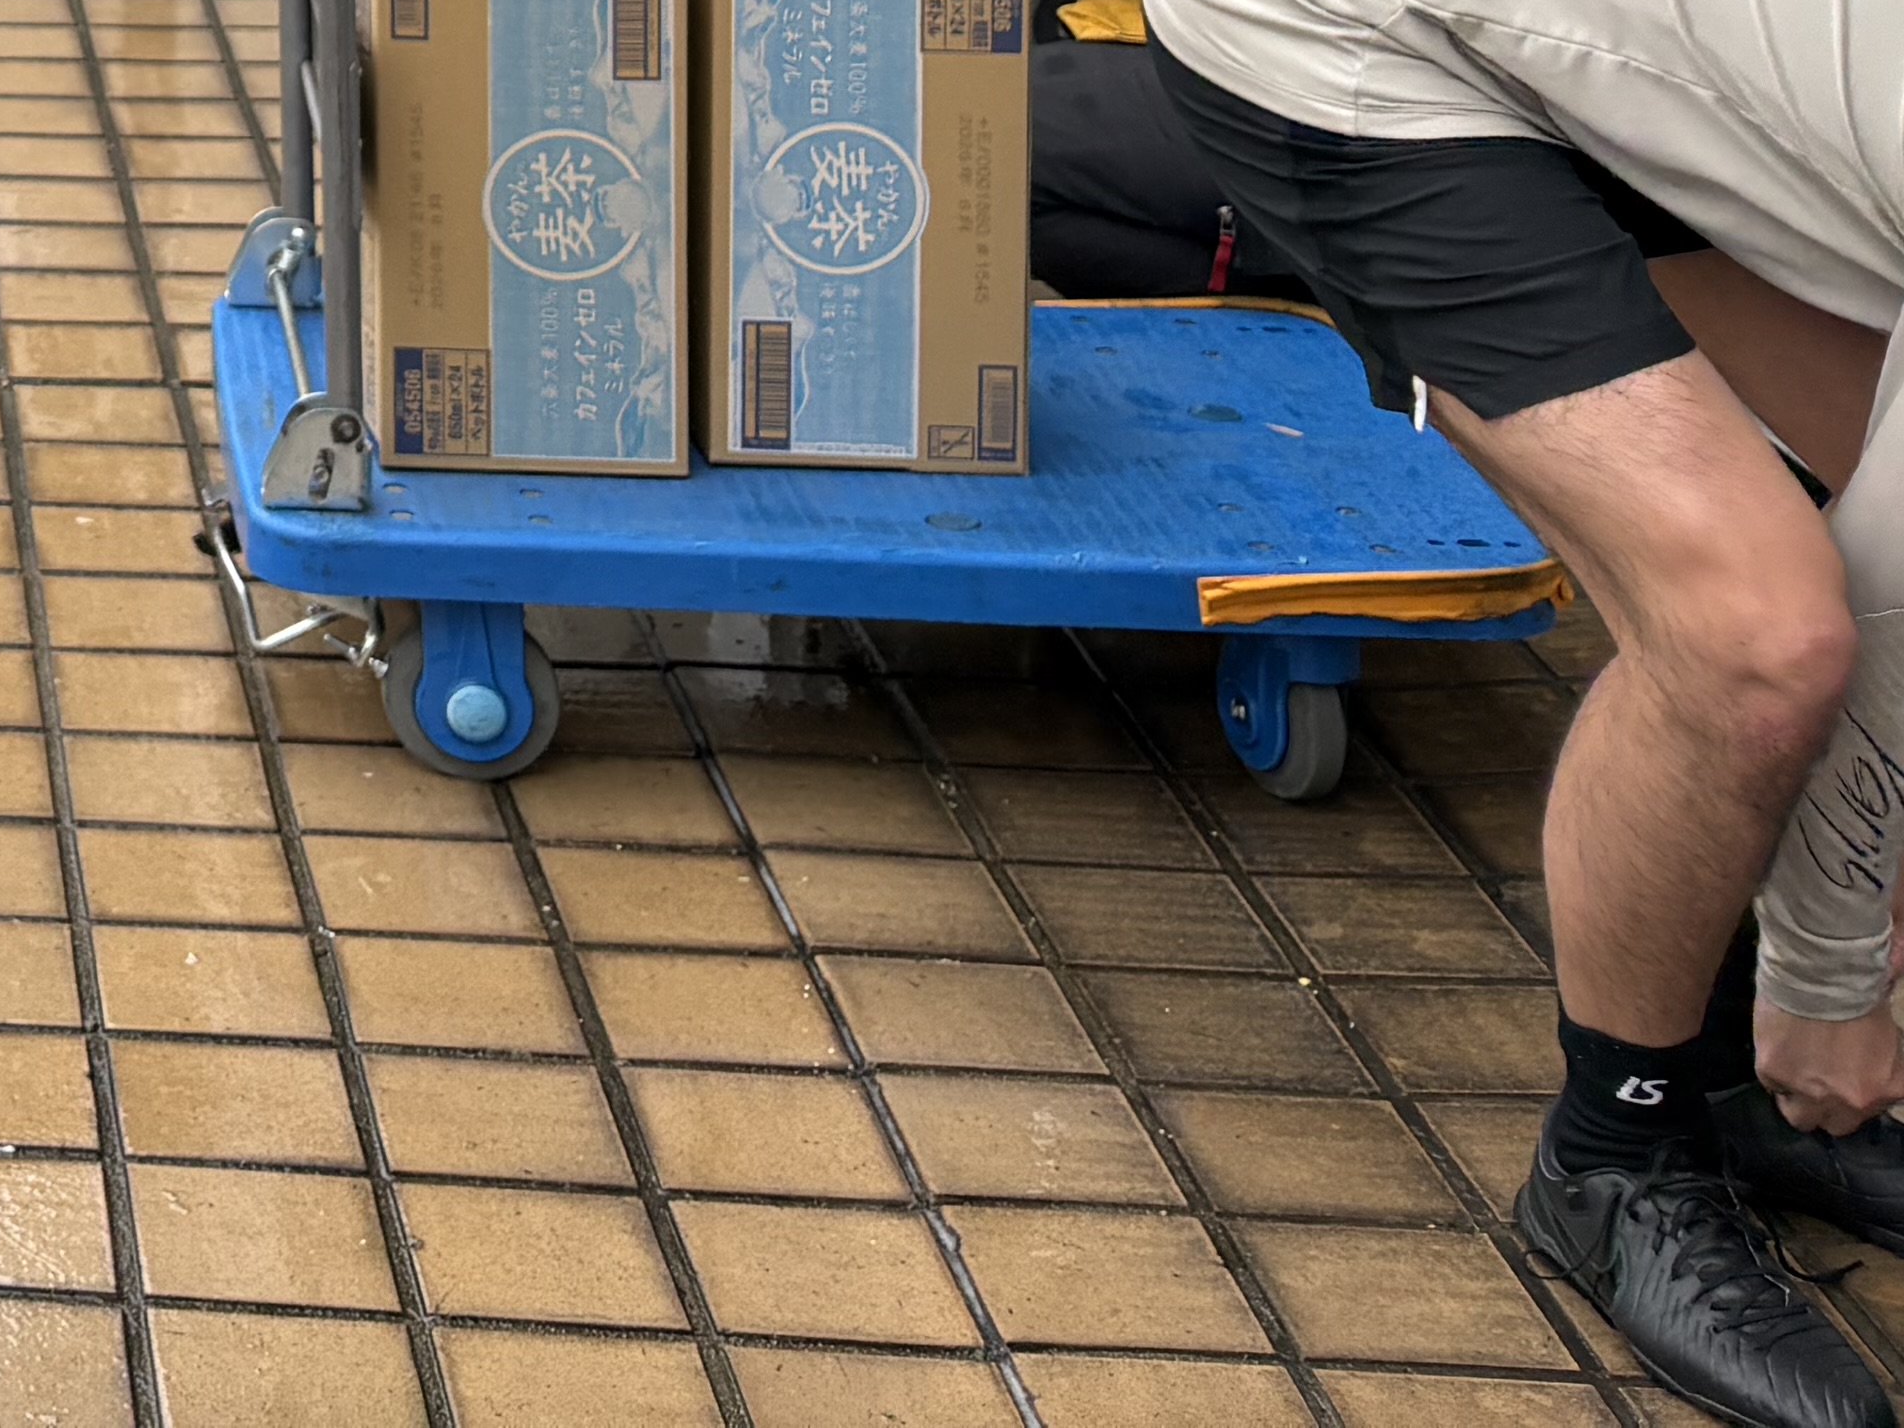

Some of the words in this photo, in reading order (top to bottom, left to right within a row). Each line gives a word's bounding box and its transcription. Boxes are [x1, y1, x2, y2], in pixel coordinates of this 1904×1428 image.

[781, 7, 802, 86] ミネラル
[533, 147, 596, 262] 麦茶
[808, 141, 875, 258] 麦茶
[573, 287, 598, 422] カフェインゼロ
[603, 317, 626, 394] ミネラル
